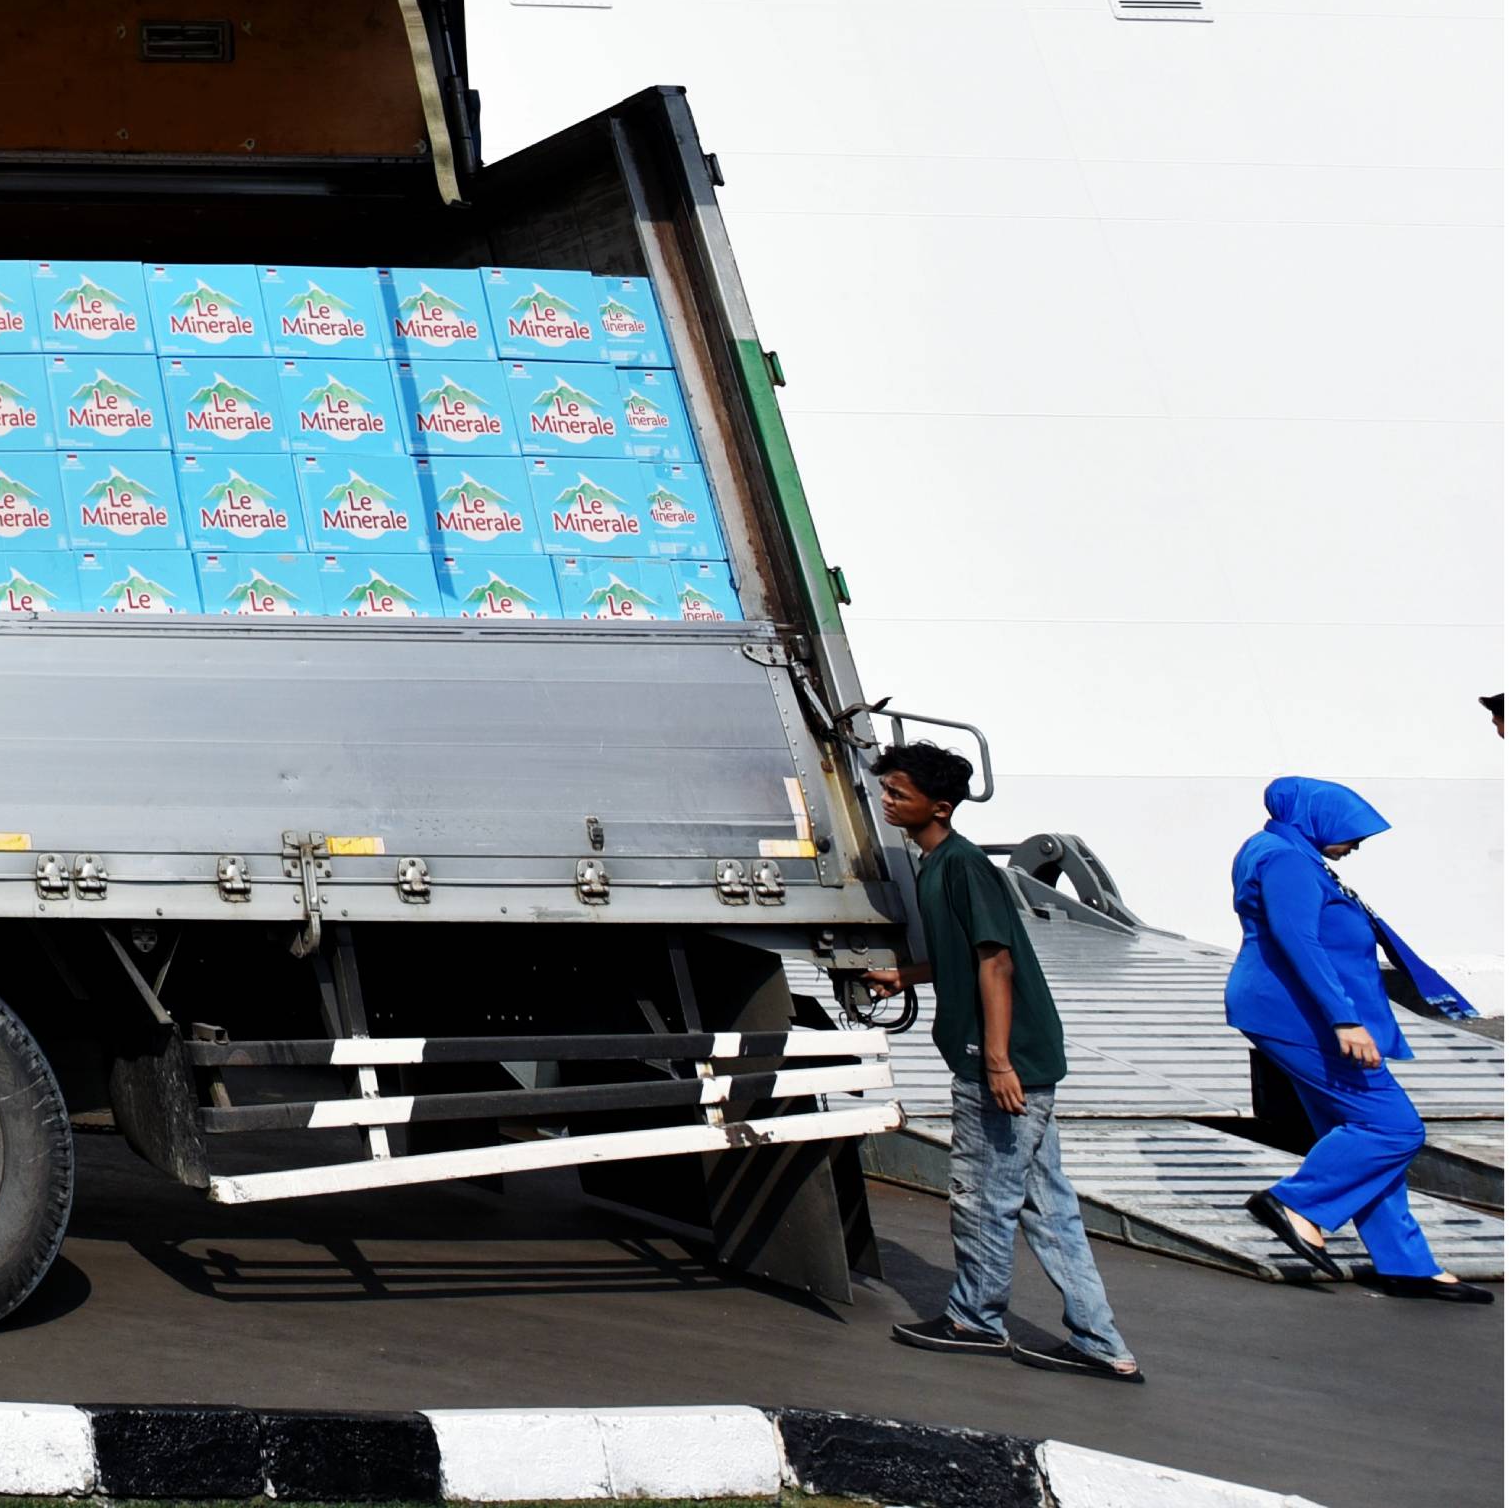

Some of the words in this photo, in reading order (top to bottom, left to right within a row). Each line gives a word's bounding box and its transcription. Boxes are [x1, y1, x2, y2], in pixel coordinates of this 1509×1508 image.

[78, 296, 104, 315] Le
[195, 299, 219, 318] Le
[307, 300, 330, 321] Le
[420, 299, 443, 319] Le
[533, 303, 557, 322] Le
[608, 310, 624, 322] Le
[54, 310, 136, 331] Minerale
[171, 313, 252, 335] Minerale
[282, 316, 364, 336] Minerale
[396, 318, 477, 339] Minerale
[510, 317, 590, 339] Minerale
[93, 390, 120, 412] Le
[211, 393, 236, 416] Le
[443, 396, 467, 418] Le
[555, 398, 580, 419] Le
[630, 403, 647, 416] Le
[69, 407, 151, 428] Minerale
[187, 411, 271, 431] Minerale
[419, 413, 501, 433] Minerale
[531, 414, 614, 435] Minerale
[228, 490, 252, 513] Le
[348, 491, 372, 513] Le
[461, 492, 486, 514] Le
[577, 495, 604, 516] Le
[656, 497, 674, 511] Le
[202, 508, 286, 528] Minerale
[324, 509, 407, 530] Minerale
[437, 509, 521, 532] Minerale
[553, 511, 638, 533] Minerale
[7, 591, 33, 613] Le
[126, 588, 150, 610] Le
[368, 591, 394, 613] Le
[608, 595, 633, 618] Le
[684, 596, 701, 611] Le
